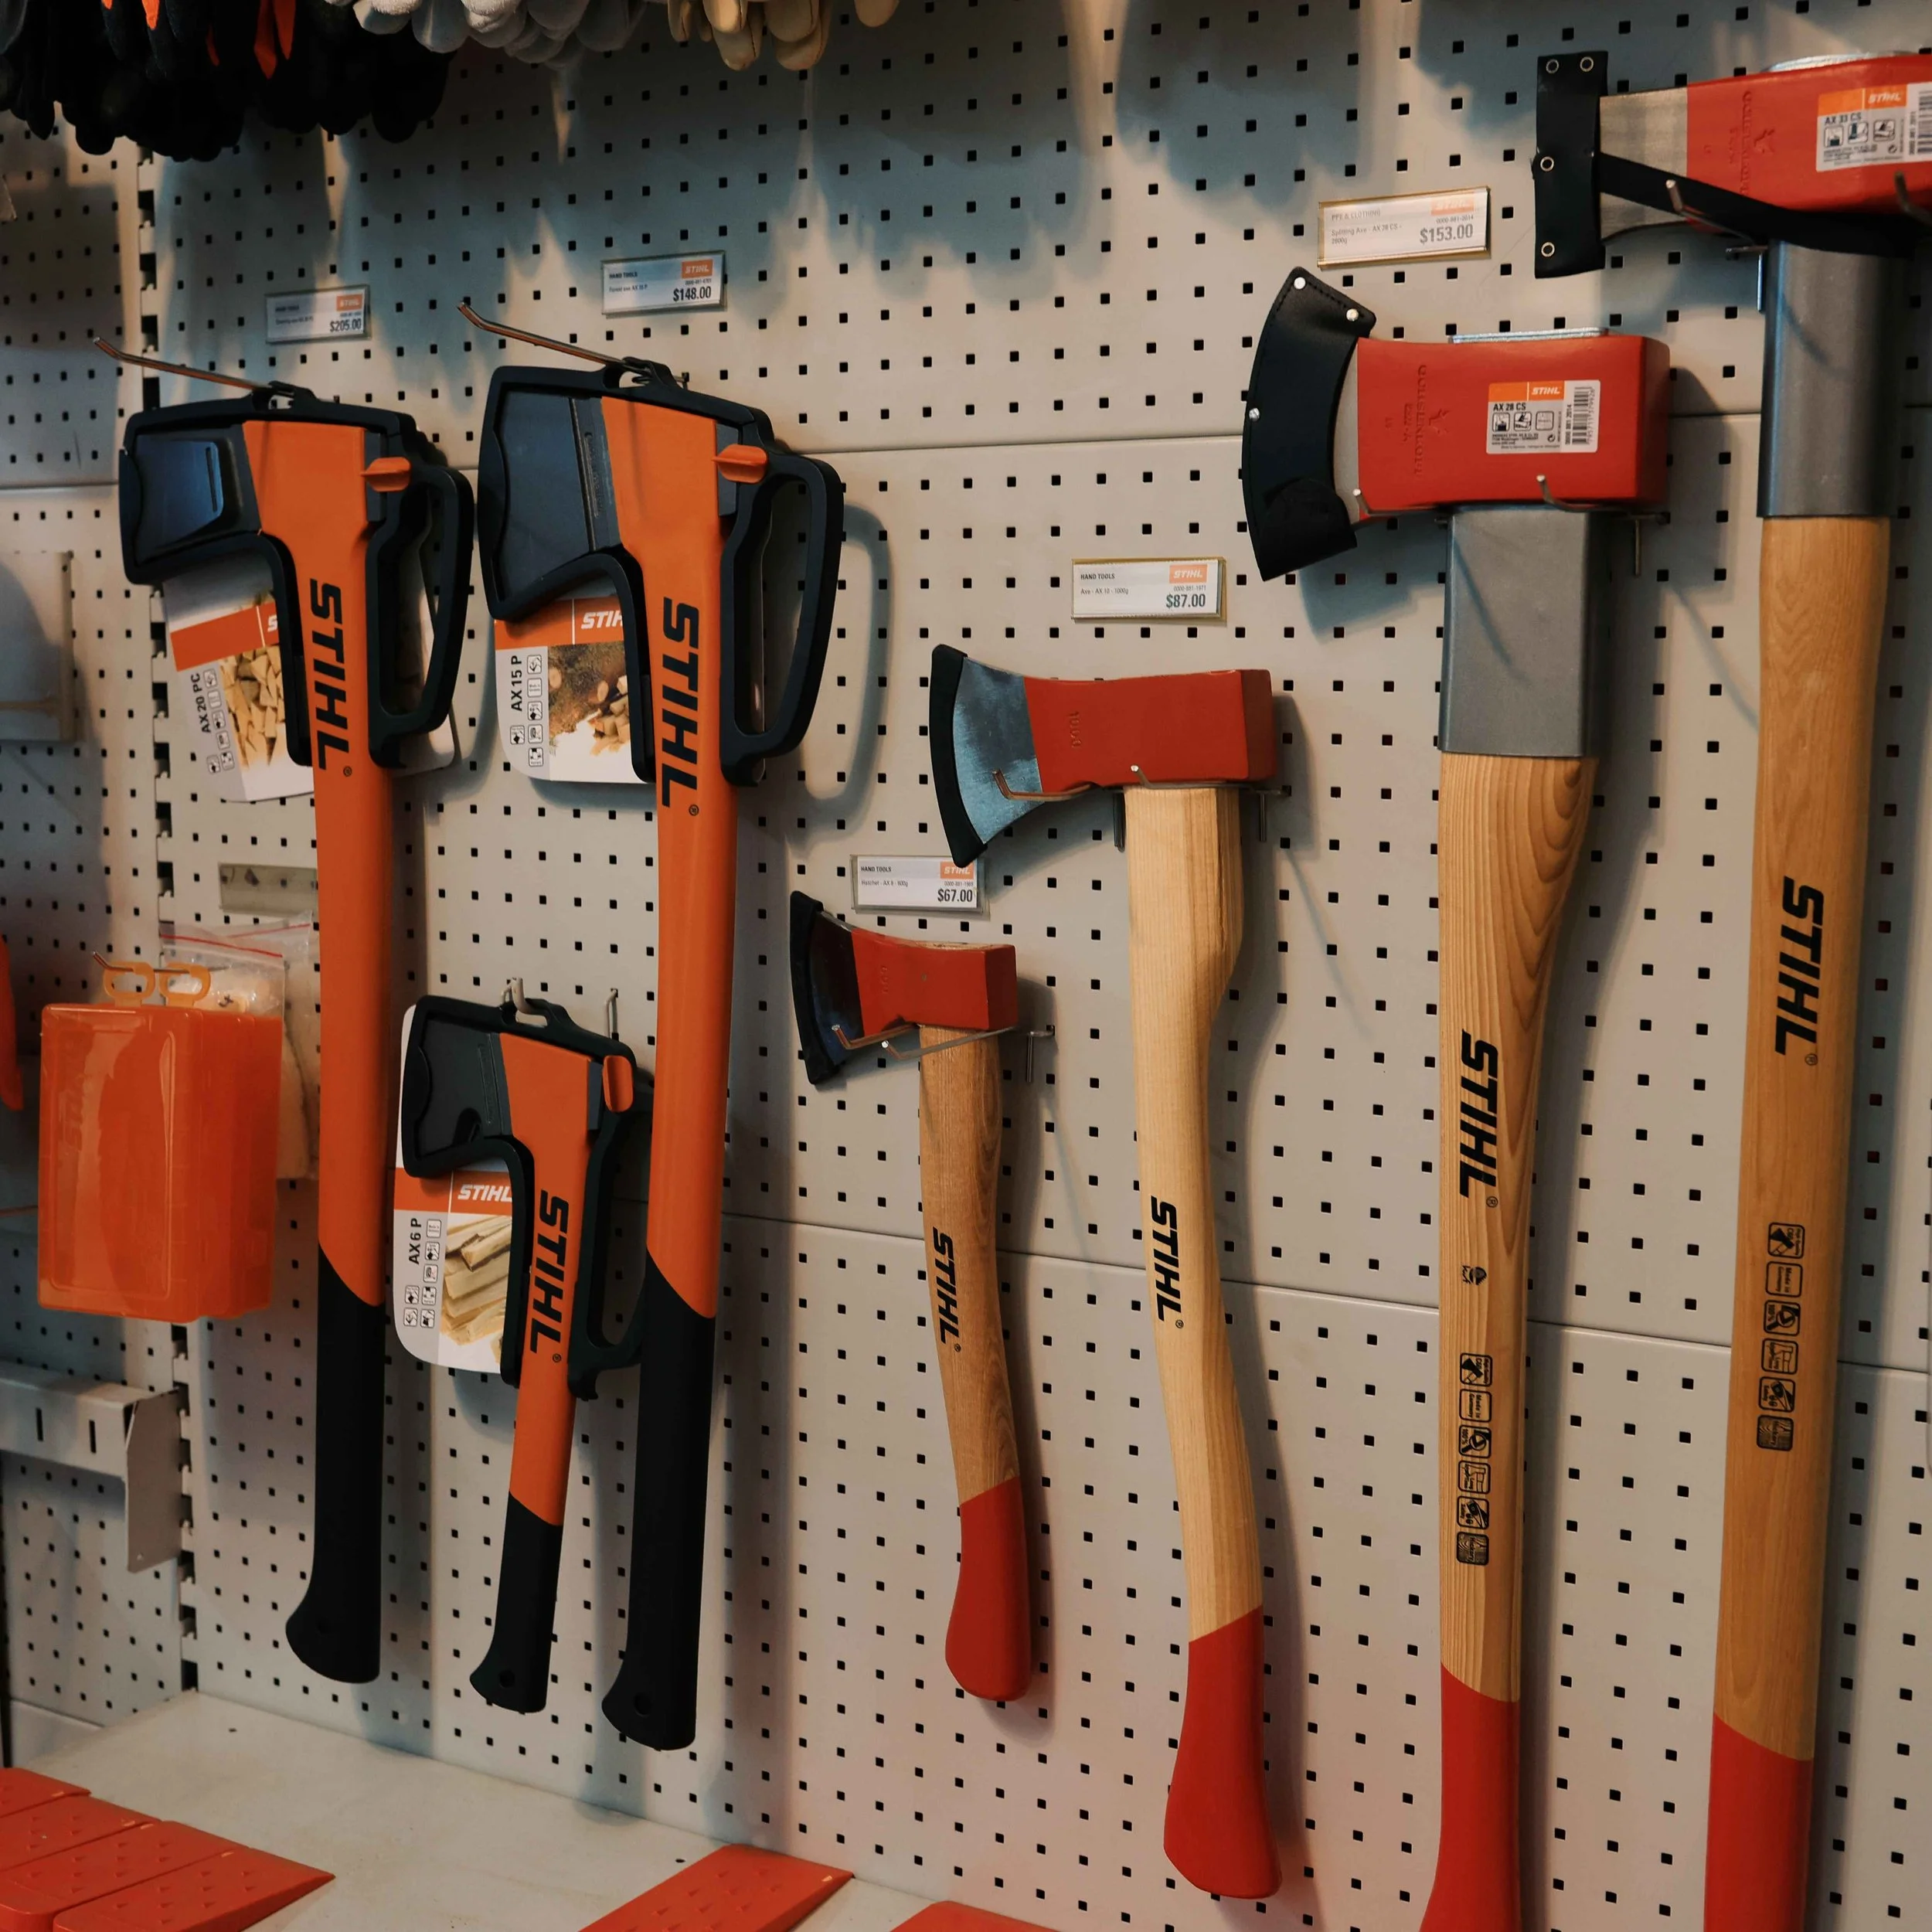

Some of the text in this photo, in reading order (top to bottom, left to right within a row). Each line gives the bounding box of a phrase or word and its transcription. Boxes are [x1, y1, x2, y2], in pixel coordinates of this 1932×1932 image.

[1868, 92, 1902, 104] STIHL
[1350, 209, 1381, 219] CLOTHING
[1332, 228, 1355, 238] Splitting
[1420, 223, 1474, 243] $153.00
[685, 264, 709, 274] STIHL
[673, 286, 712, 301] $148.00
[330, 318, 362, 332] $205.00
[1532, 386, 1560, 396] STIHL
[1516, 402, 1526, 410] CS
[1173, 570, 1203, 579] STIHL
[1166, 593, 1206, 609] $87.00
[581, 610, 623, 630] STIH
[310, 578, 349, 770] STIHL
[511, 655, 522, 712] AX 15 P
[191, 673, 212, 733] AX 20 PC
[662, 596, 699, 808] STIHL
[937, 888, 973, 903] $67.00
[1774, 875, 1824, 1056] STIHL
[1460, 1028, 1498, 1199] STIHL
[457, 1184, 512, 1202] STIHL
[409, 1218, 422, 1265] AX 6 P
[1151, 1195, 1182, 1321] STIHL
[530, 1189, 569, 1354] STIHL
[932, 1226, 960, 1344] STIHL
